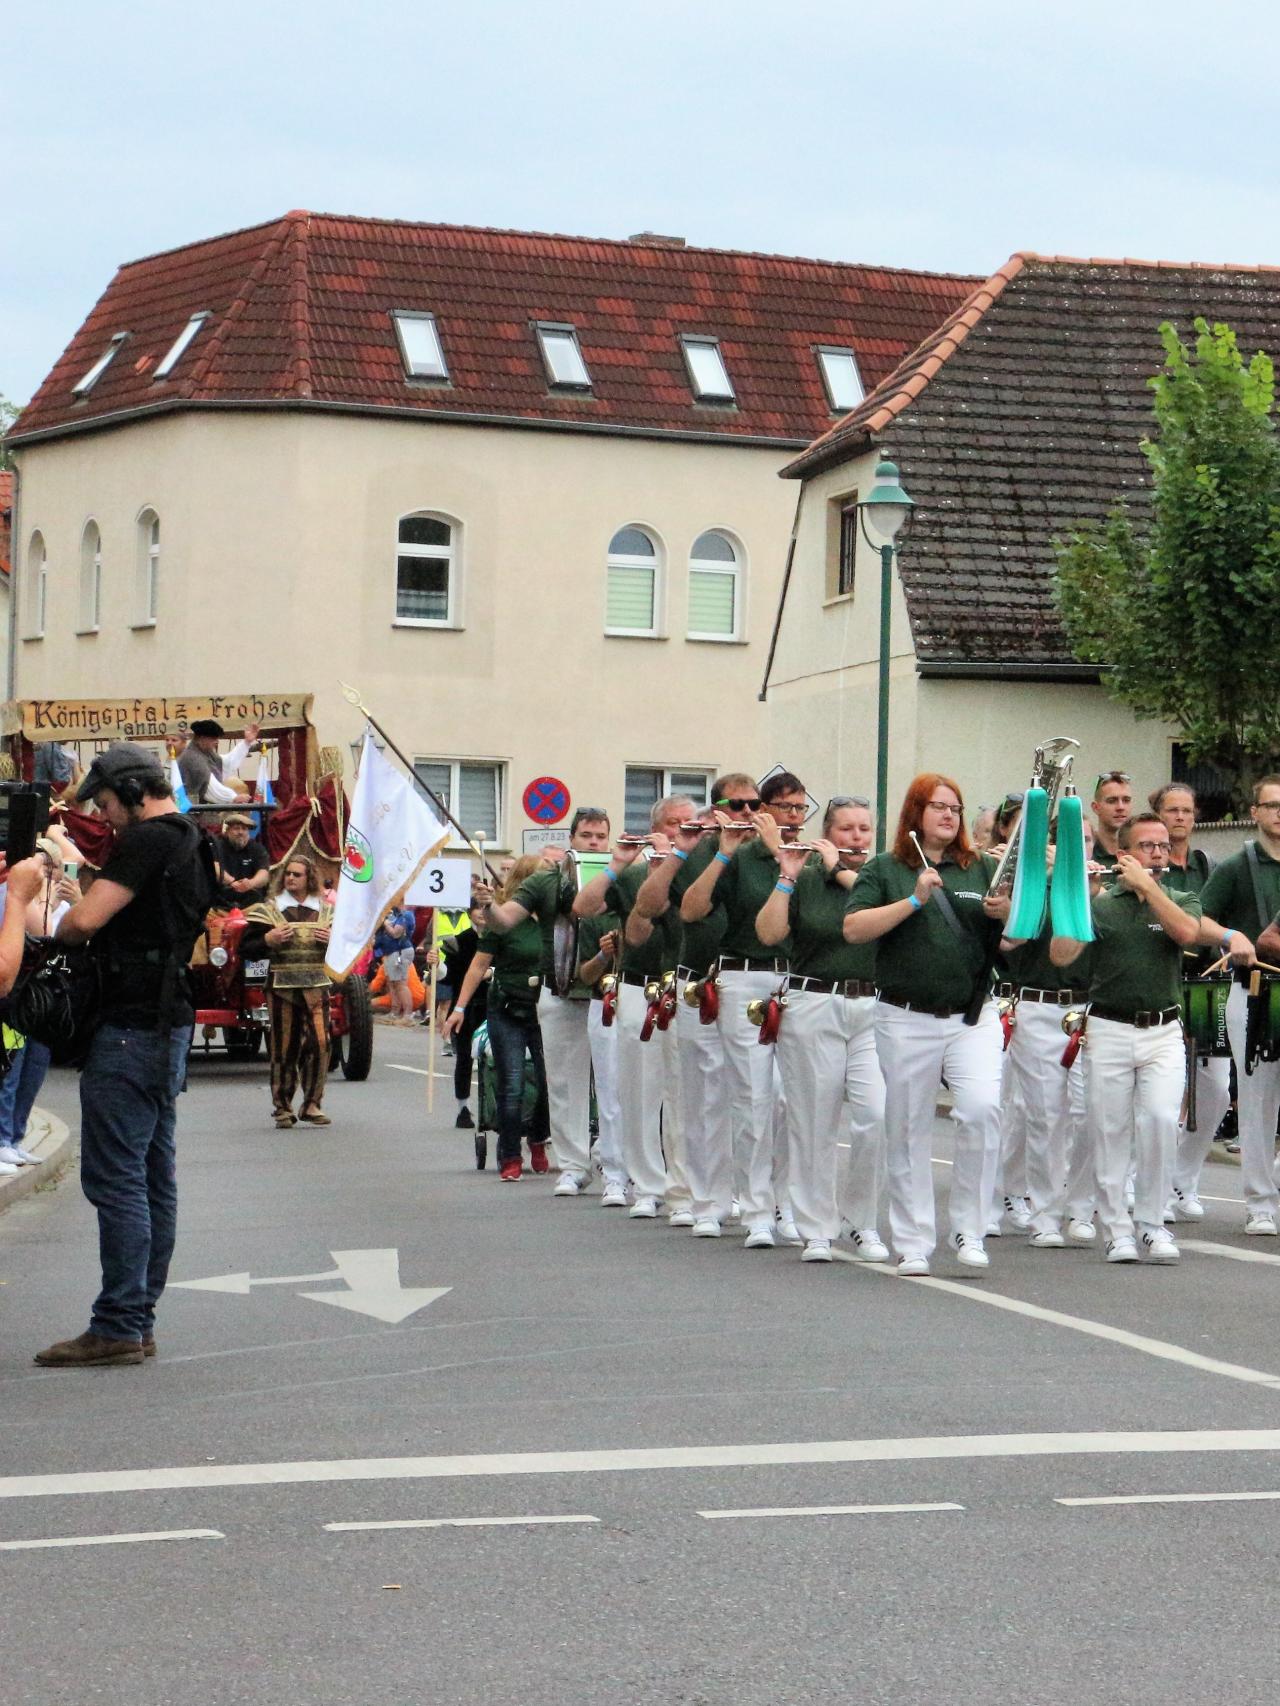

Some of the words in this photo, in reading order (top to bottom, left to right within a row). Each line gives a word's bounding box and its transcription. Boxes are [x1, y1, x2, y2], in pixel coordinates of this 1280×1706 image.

[30, 698, 189, 733] Königspfalz
[209, 695, 292, 721] Frohse
[123, 721, 167, 736] anno
[429, 869, 444, 893] 3
[1216, 1003, 1227, 1048] Bernburg
